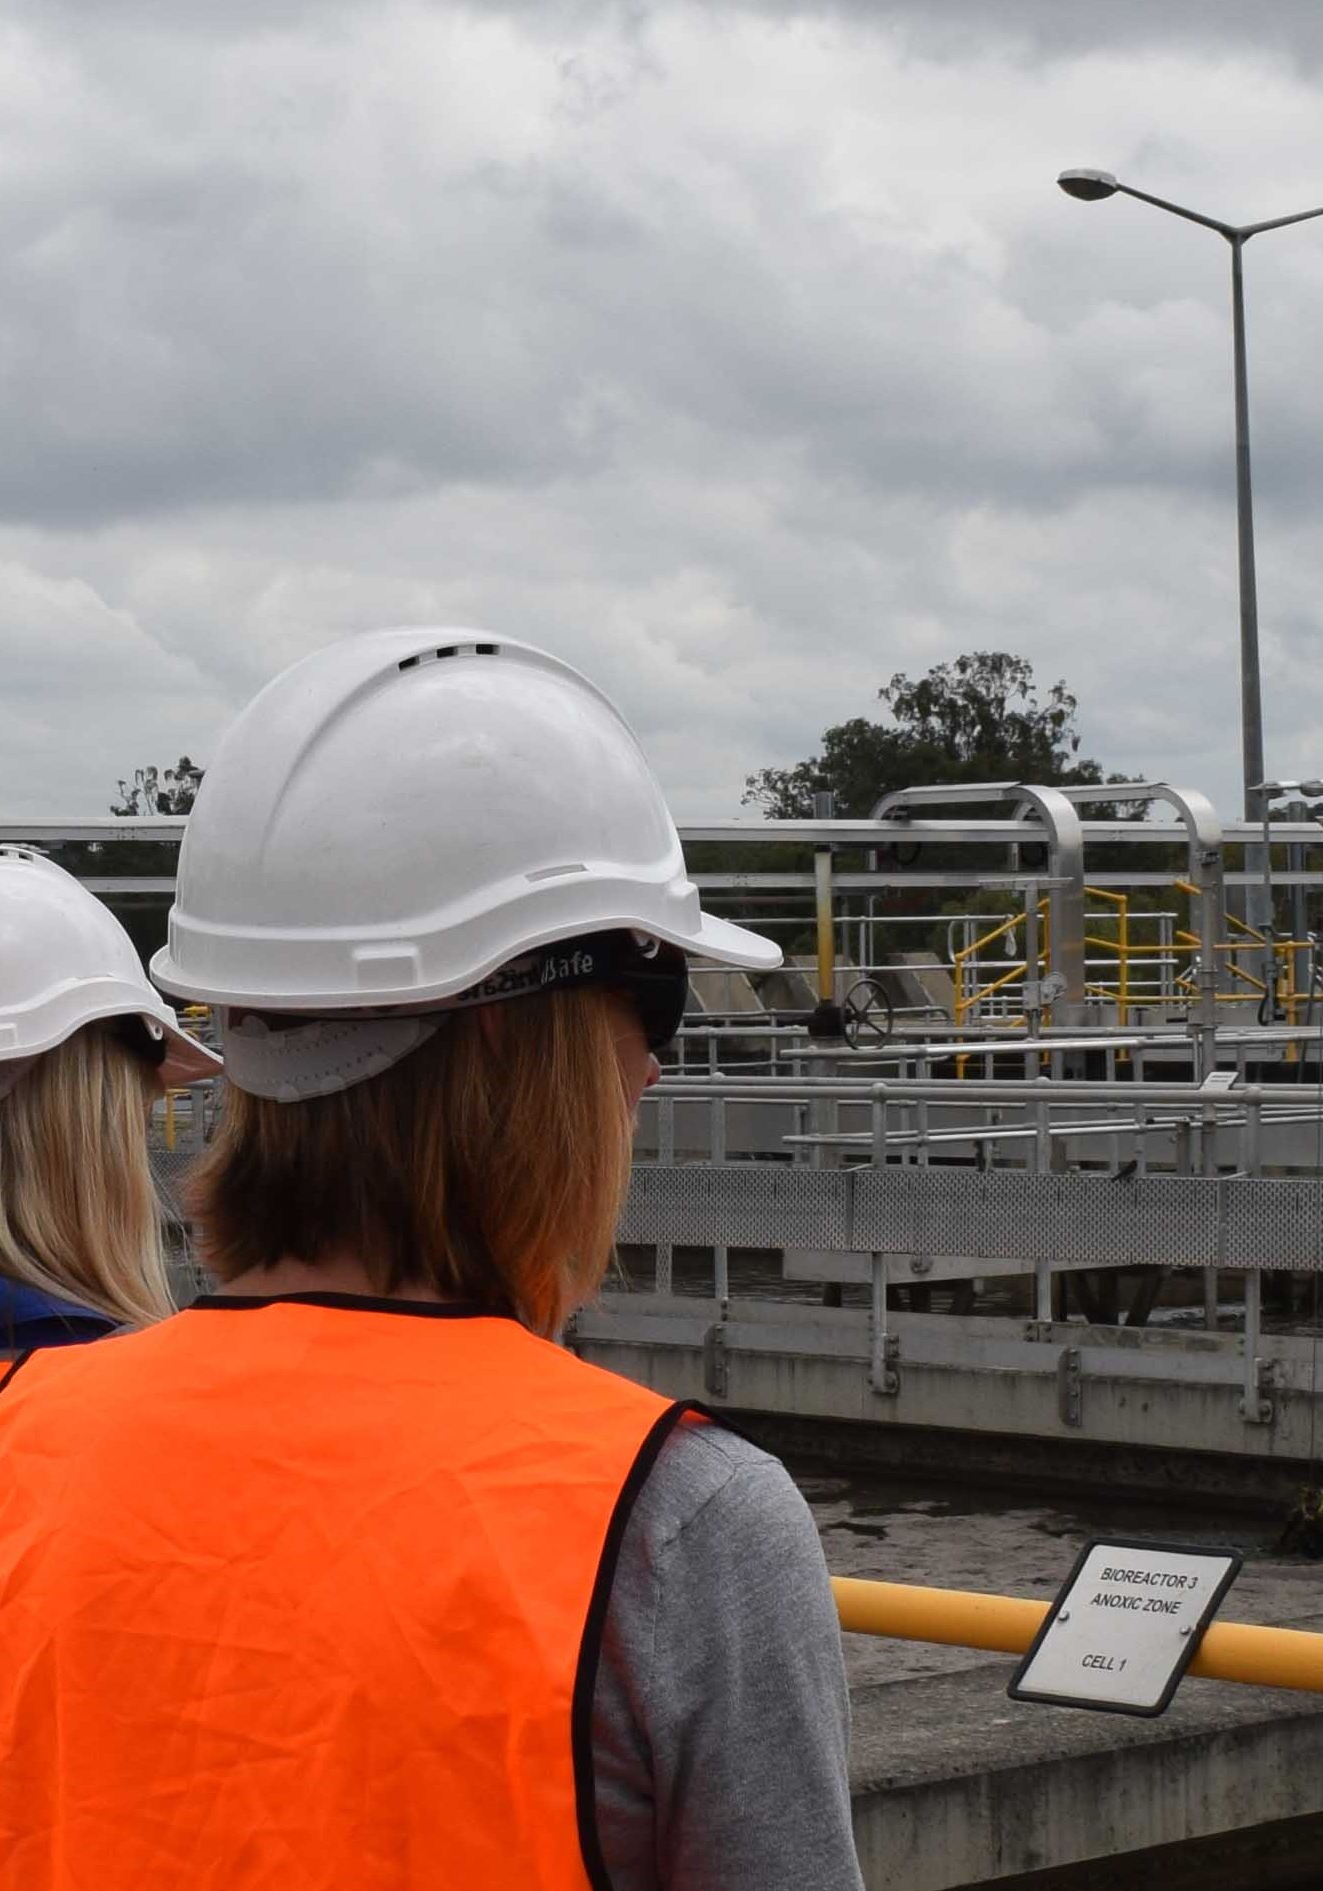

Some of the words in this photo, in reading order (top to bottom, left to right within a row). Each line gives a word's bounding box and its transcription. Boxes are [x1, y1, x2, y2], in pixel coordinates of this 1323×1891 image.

[1100, 1567, 1188, 1589] BIOREACTOR
[1188, 1576, 1199, 1590] 3
[1090, 1592, 1143, 1611] ANOXIC
[1142, 1598, 1182, 1615] ZONE
[1081, 1654, 1115, 1671] CELL
[1118, 1658, 1127, 1672] 1
